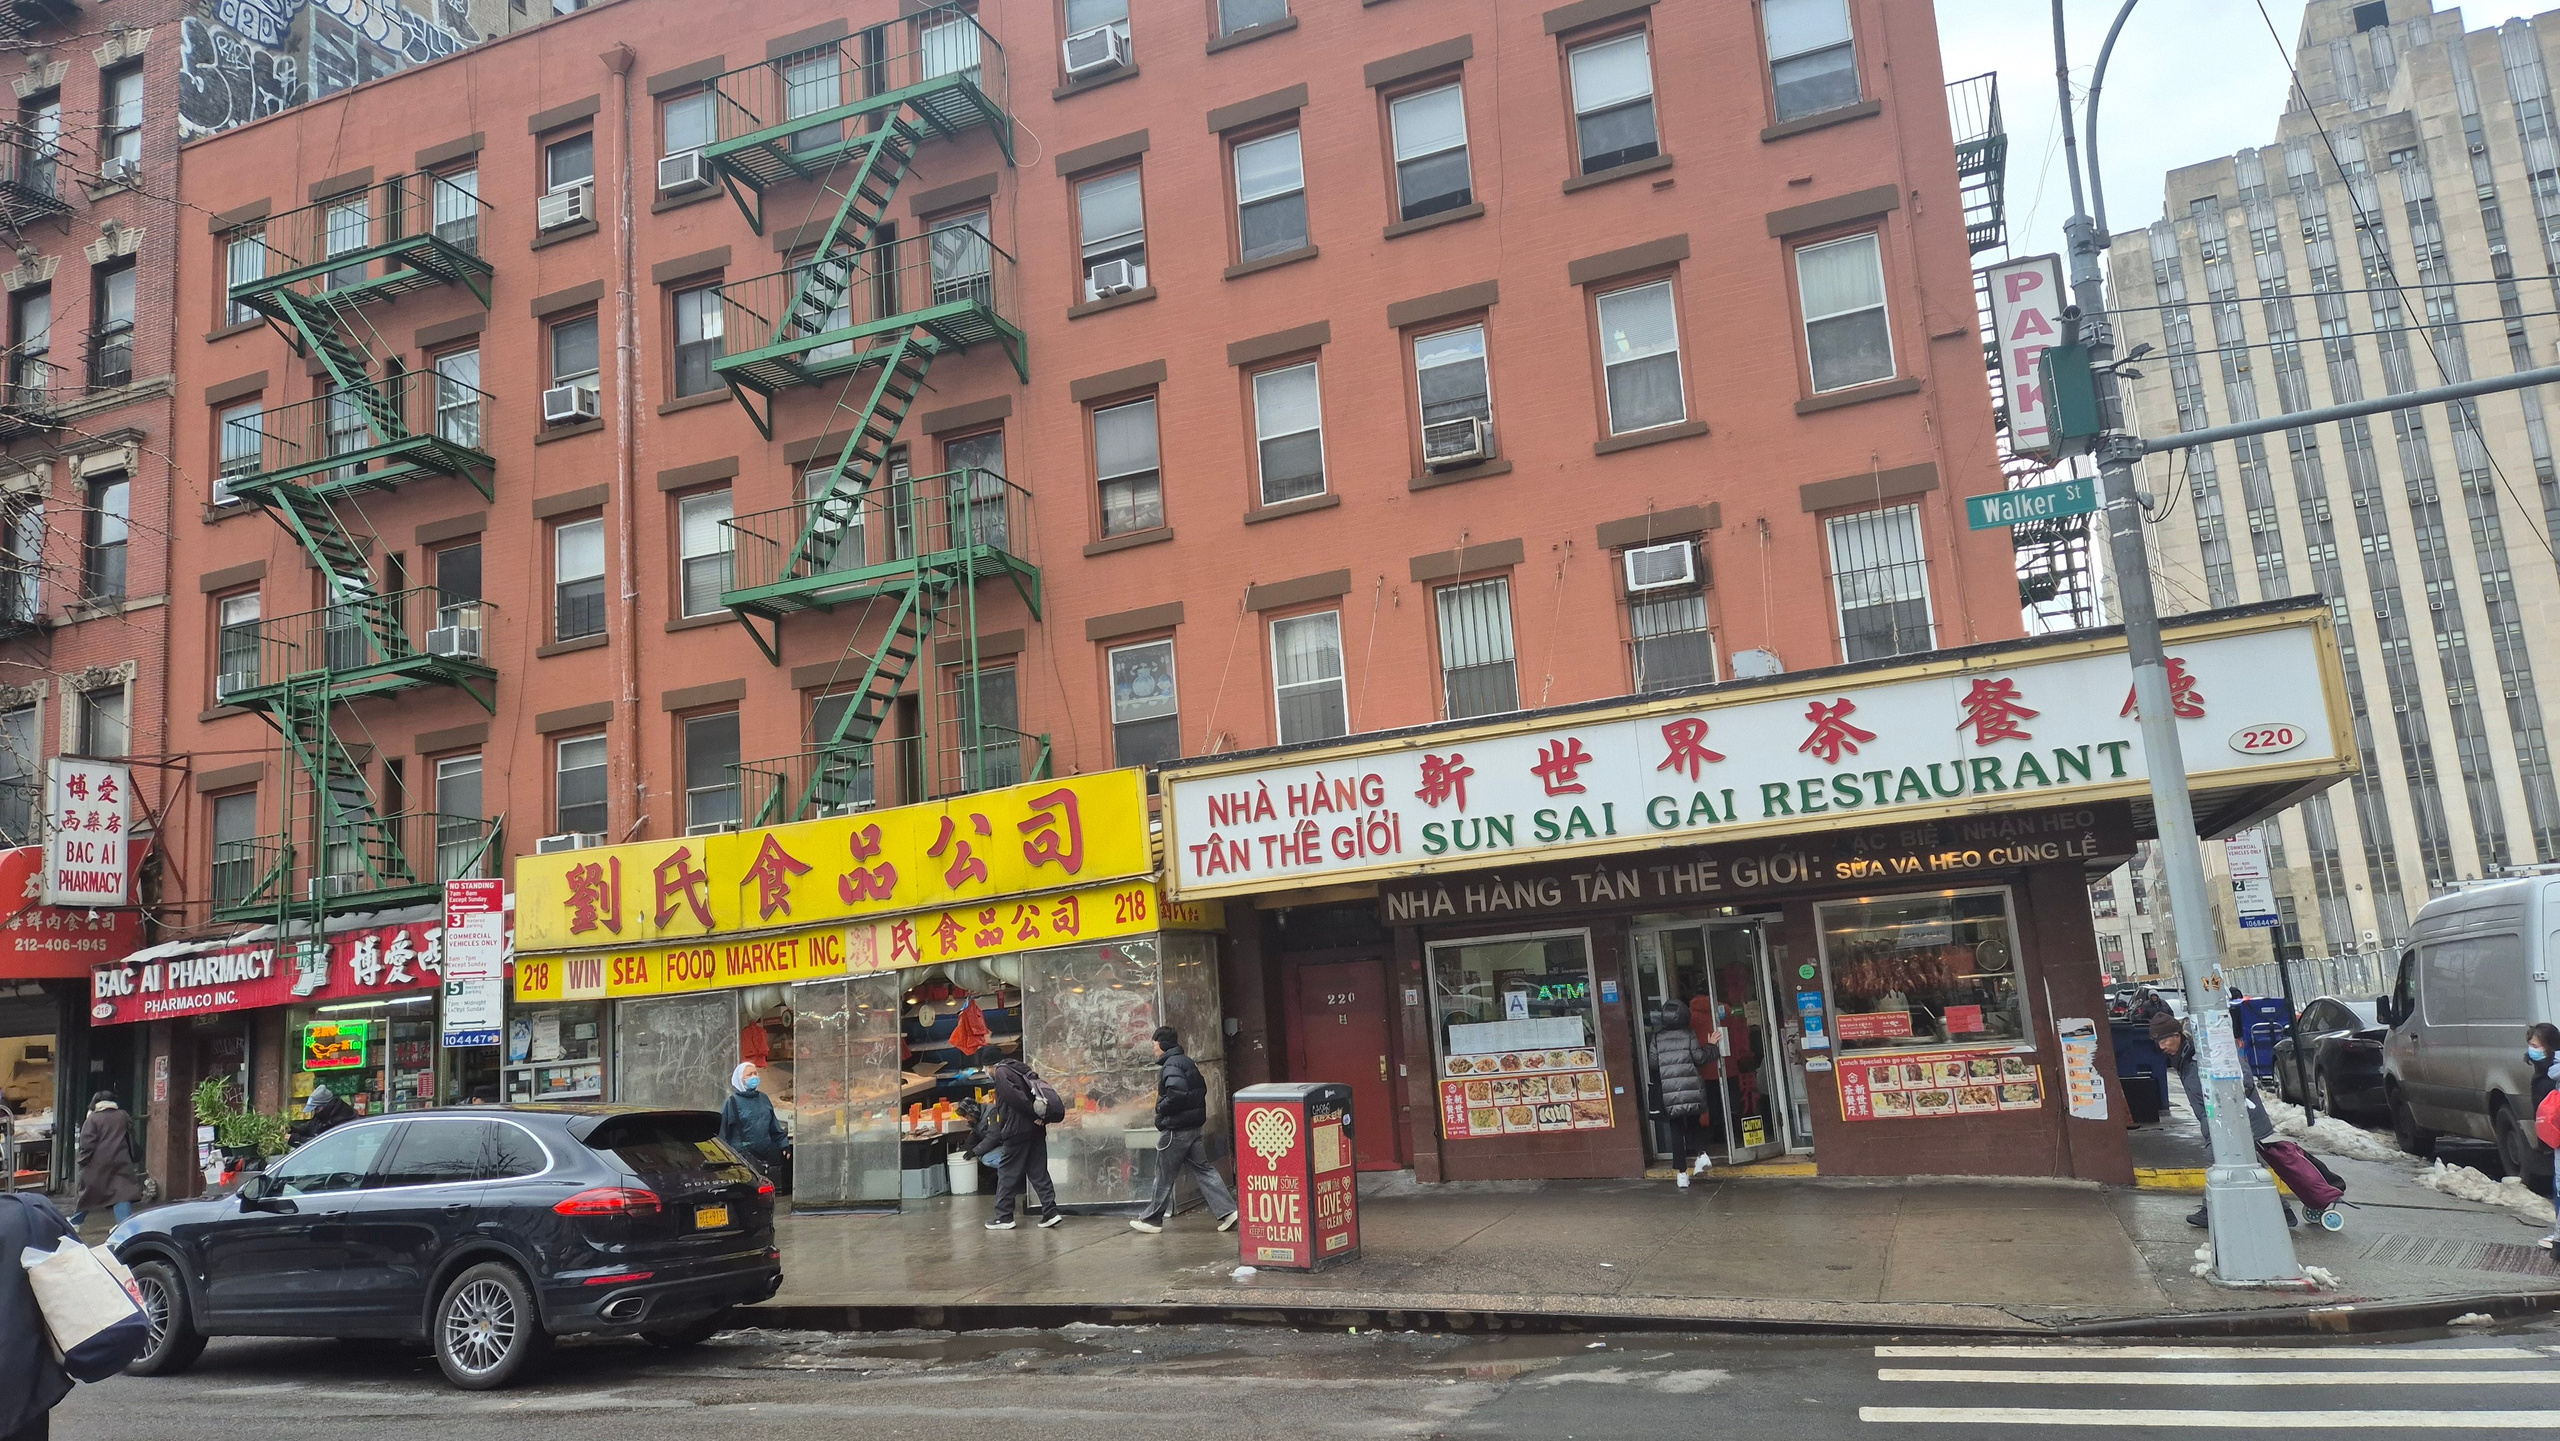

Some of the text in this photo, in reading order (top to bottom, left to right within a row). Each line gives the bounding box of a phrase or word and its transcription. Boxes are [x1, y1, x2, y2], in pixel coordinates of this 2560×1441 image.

[1982, 483, 2082, 523] Walker St
[2242, 728, 2294, 750] 220
[66, 773, 119, 804] 博愛
[1208, 771, 1385, 827] NHÀ HÀNG
[1421, 740, 2131, 855] SUN SAI GAI RESTAURANT
[61, 809, 122, 834] 西藥房
[2042, 809, 2096, 832] HEO
[66, 841, 94, 864] BAC
[1189, 833, 1250, 877] TÂN
[1258, 819, 1323, 868] THẾ
[563, 788, 1083, 936] 劉氏食品公司
[59, 869, 122, 894] PHARMACY
[1387, 881, 1455, 921] NHÀ
[1465, 875, 1562, 914] HÀNG
[1571, 862, 1641, 904] TÂN
[1889, 850, 1924, 874] VÀ
[1930, 850, 1982, 872] HEO
[1988, 840, 2060, 865] CÚNG
[2235, 881, 2243, 891] 2
[6, 911, 116, 932] 海鮮肉食公司
[451, 914, 461, 927] 3
[849, 889, 1147, 969] 劉氏食品公司 218
[15, 938, 107, 951] 212-406-1945
[95, 948, 275, 999] BAC AI PHARMACY
[523, 935, 846, 992] 218 WIN SEA FOOD MARKET INC.
[449, 982, 460, 995] 5
[1327, 993, 1355, 1005] 220
[1537, 983, 1585, 1001] ATM
[97, 1006, 110, 1015] 216
[144, 990, 239, 1014] PHARMACO INC.
[1510, 995, 1524, 1012] A
[445, 1034, 487, 1046] 104447
[1860, 1058, 1883, 1066] Special
[1855, 1084, 1869, 1115] 新世界
[1247, 1175, 1299, 1191] SHOW SOME
[1317, 1180, 1332, 1195] SHOW
[1247, 1193, 1302, 1224] LOVE
[1318, 1191, 1342, 1218] LOVE
[1326, 1214, 1343, 1230] CLEAN
[1267, 1226, 1303, 1243] CLEAN
